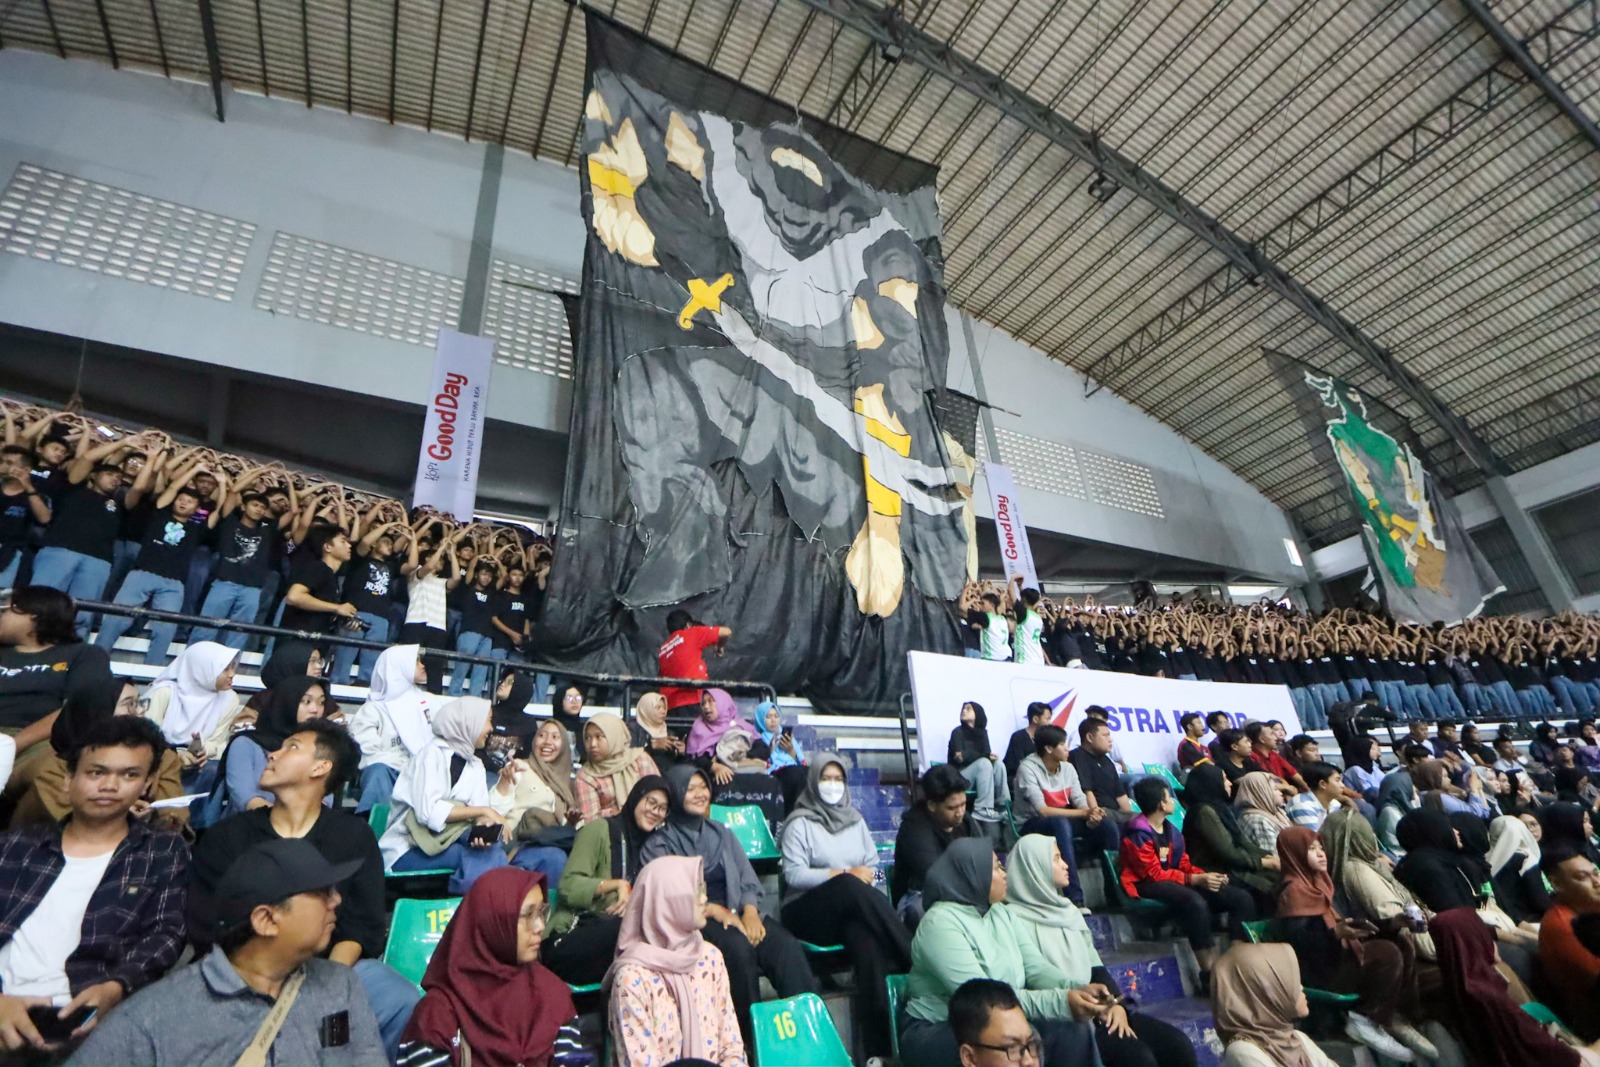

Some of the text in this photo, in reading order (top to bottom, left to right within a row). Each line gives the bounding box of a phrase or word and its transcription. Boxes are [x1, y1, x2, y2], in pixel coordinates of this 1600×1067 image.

[464, 458, 472, 482] KARENA
[1103, 705, 1248, 735] STRA MOR
[773, 1010, 797, 1041] 16
